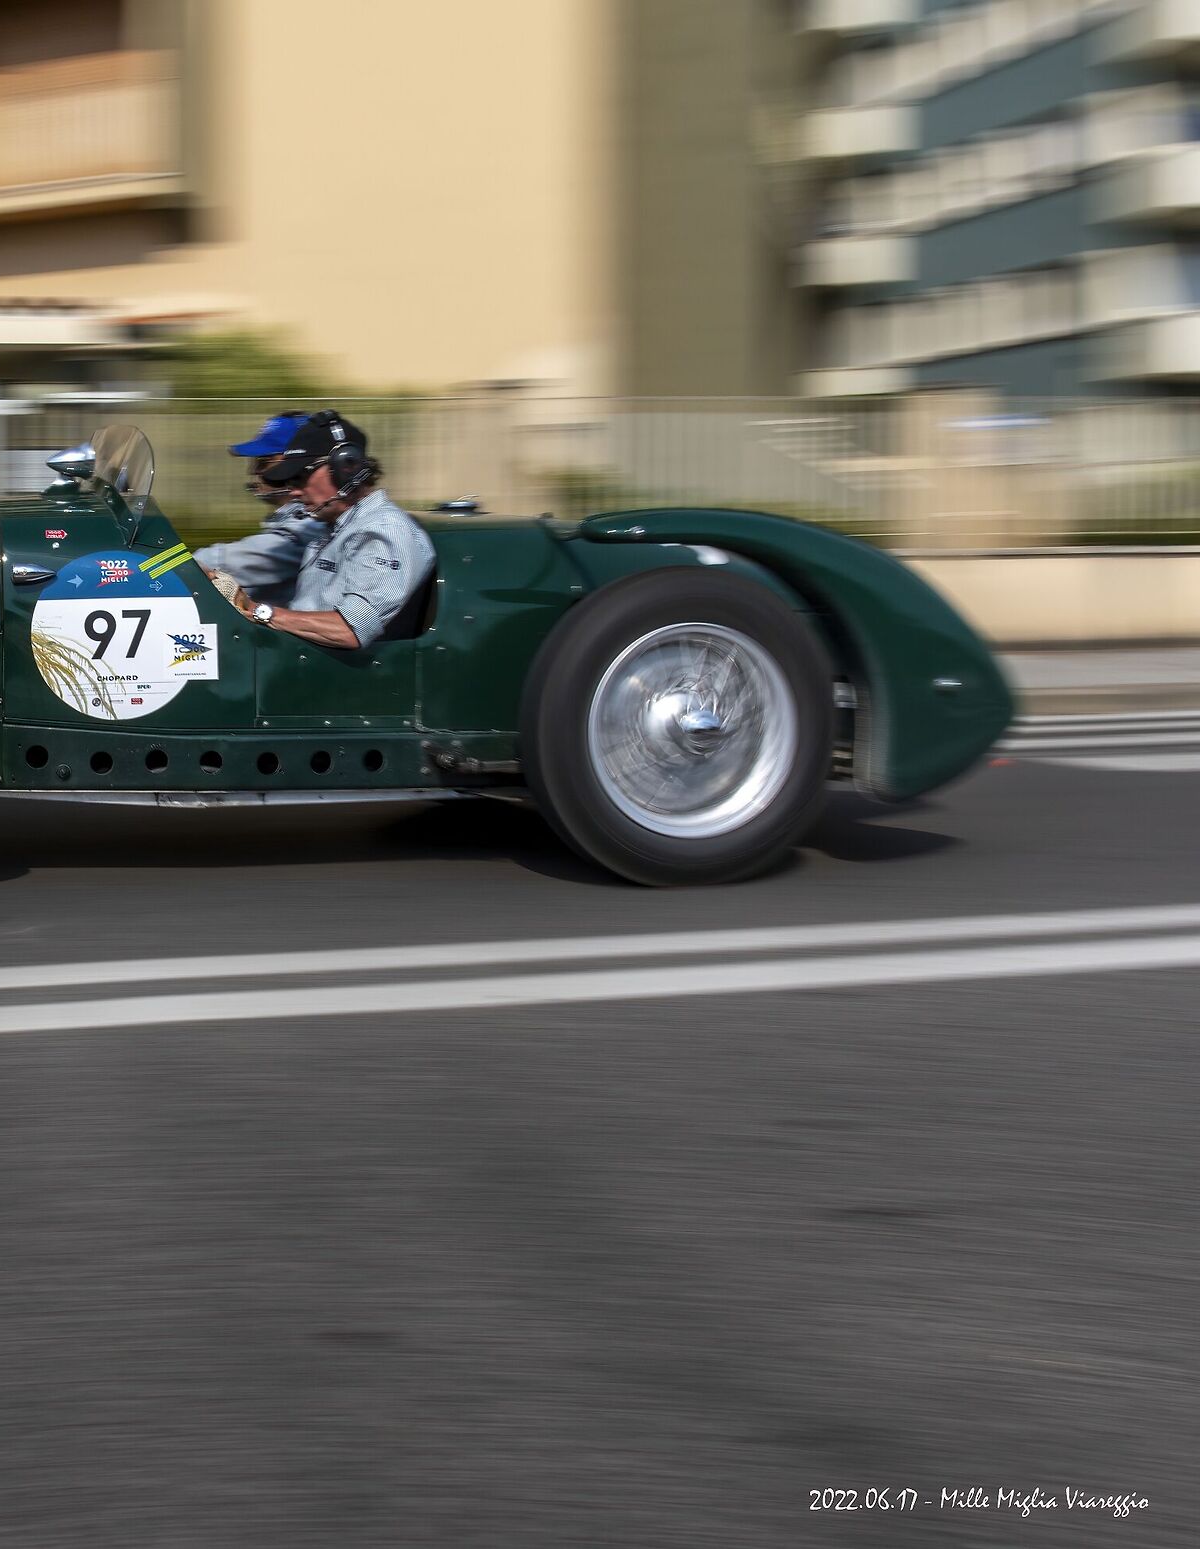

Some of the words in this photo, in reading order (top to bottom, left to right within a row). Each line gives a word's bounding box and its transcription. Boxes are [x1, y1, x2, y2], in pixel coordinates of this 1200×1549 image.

[100, 559, 128, 570] 2022
[84, 609, 151, 660] 97
[174, 634, 205, 645] 2022
